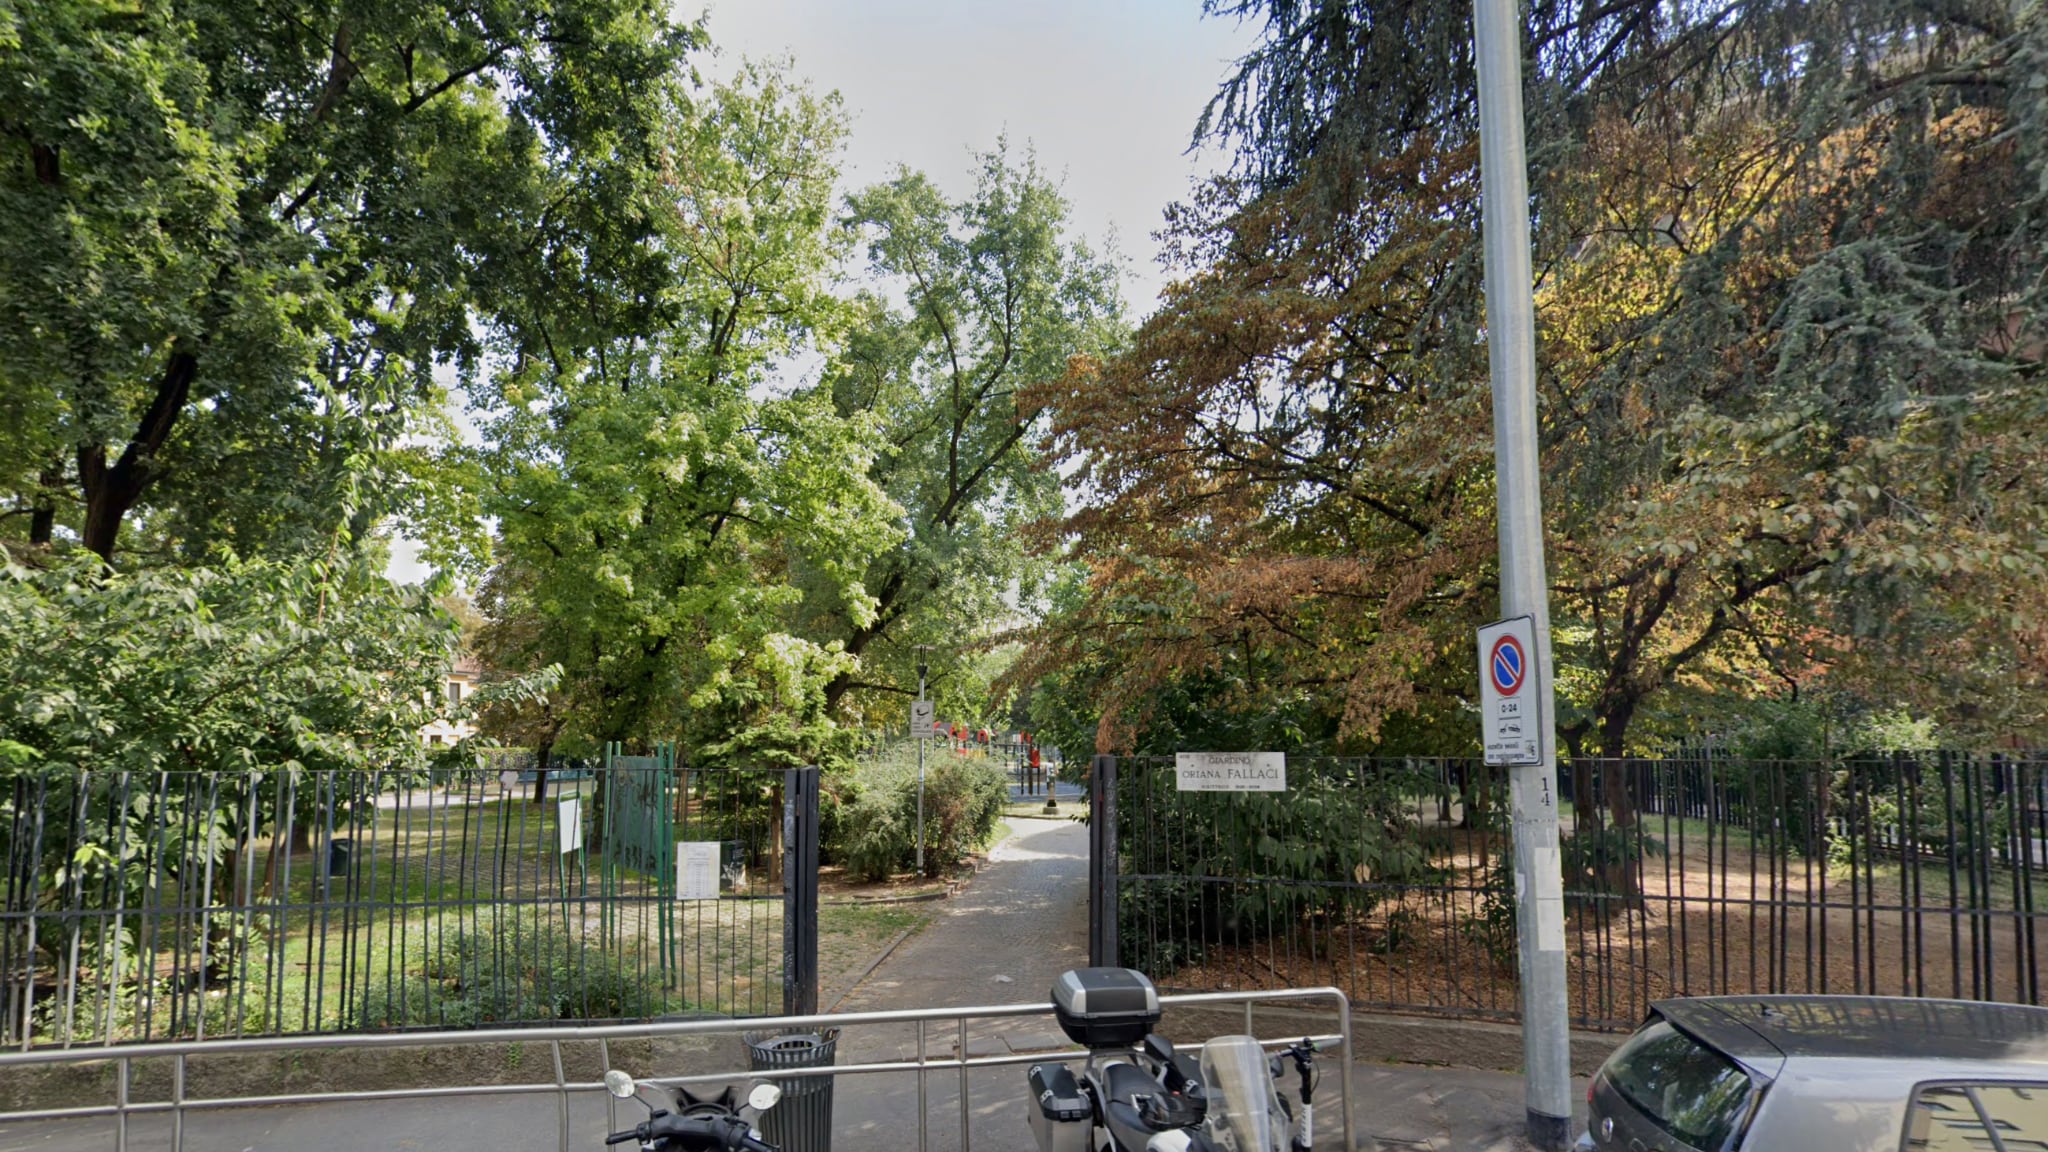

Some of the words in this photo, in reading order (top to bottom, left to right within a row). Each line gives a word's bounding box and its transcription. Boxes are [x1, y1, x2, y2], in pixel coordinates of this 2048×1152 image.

[1208, 756, 1251, 765] GIARDINO
[1182, 770, 1221, 779] ORIANA
[1227, 768, 1279, 779] FALLACI
